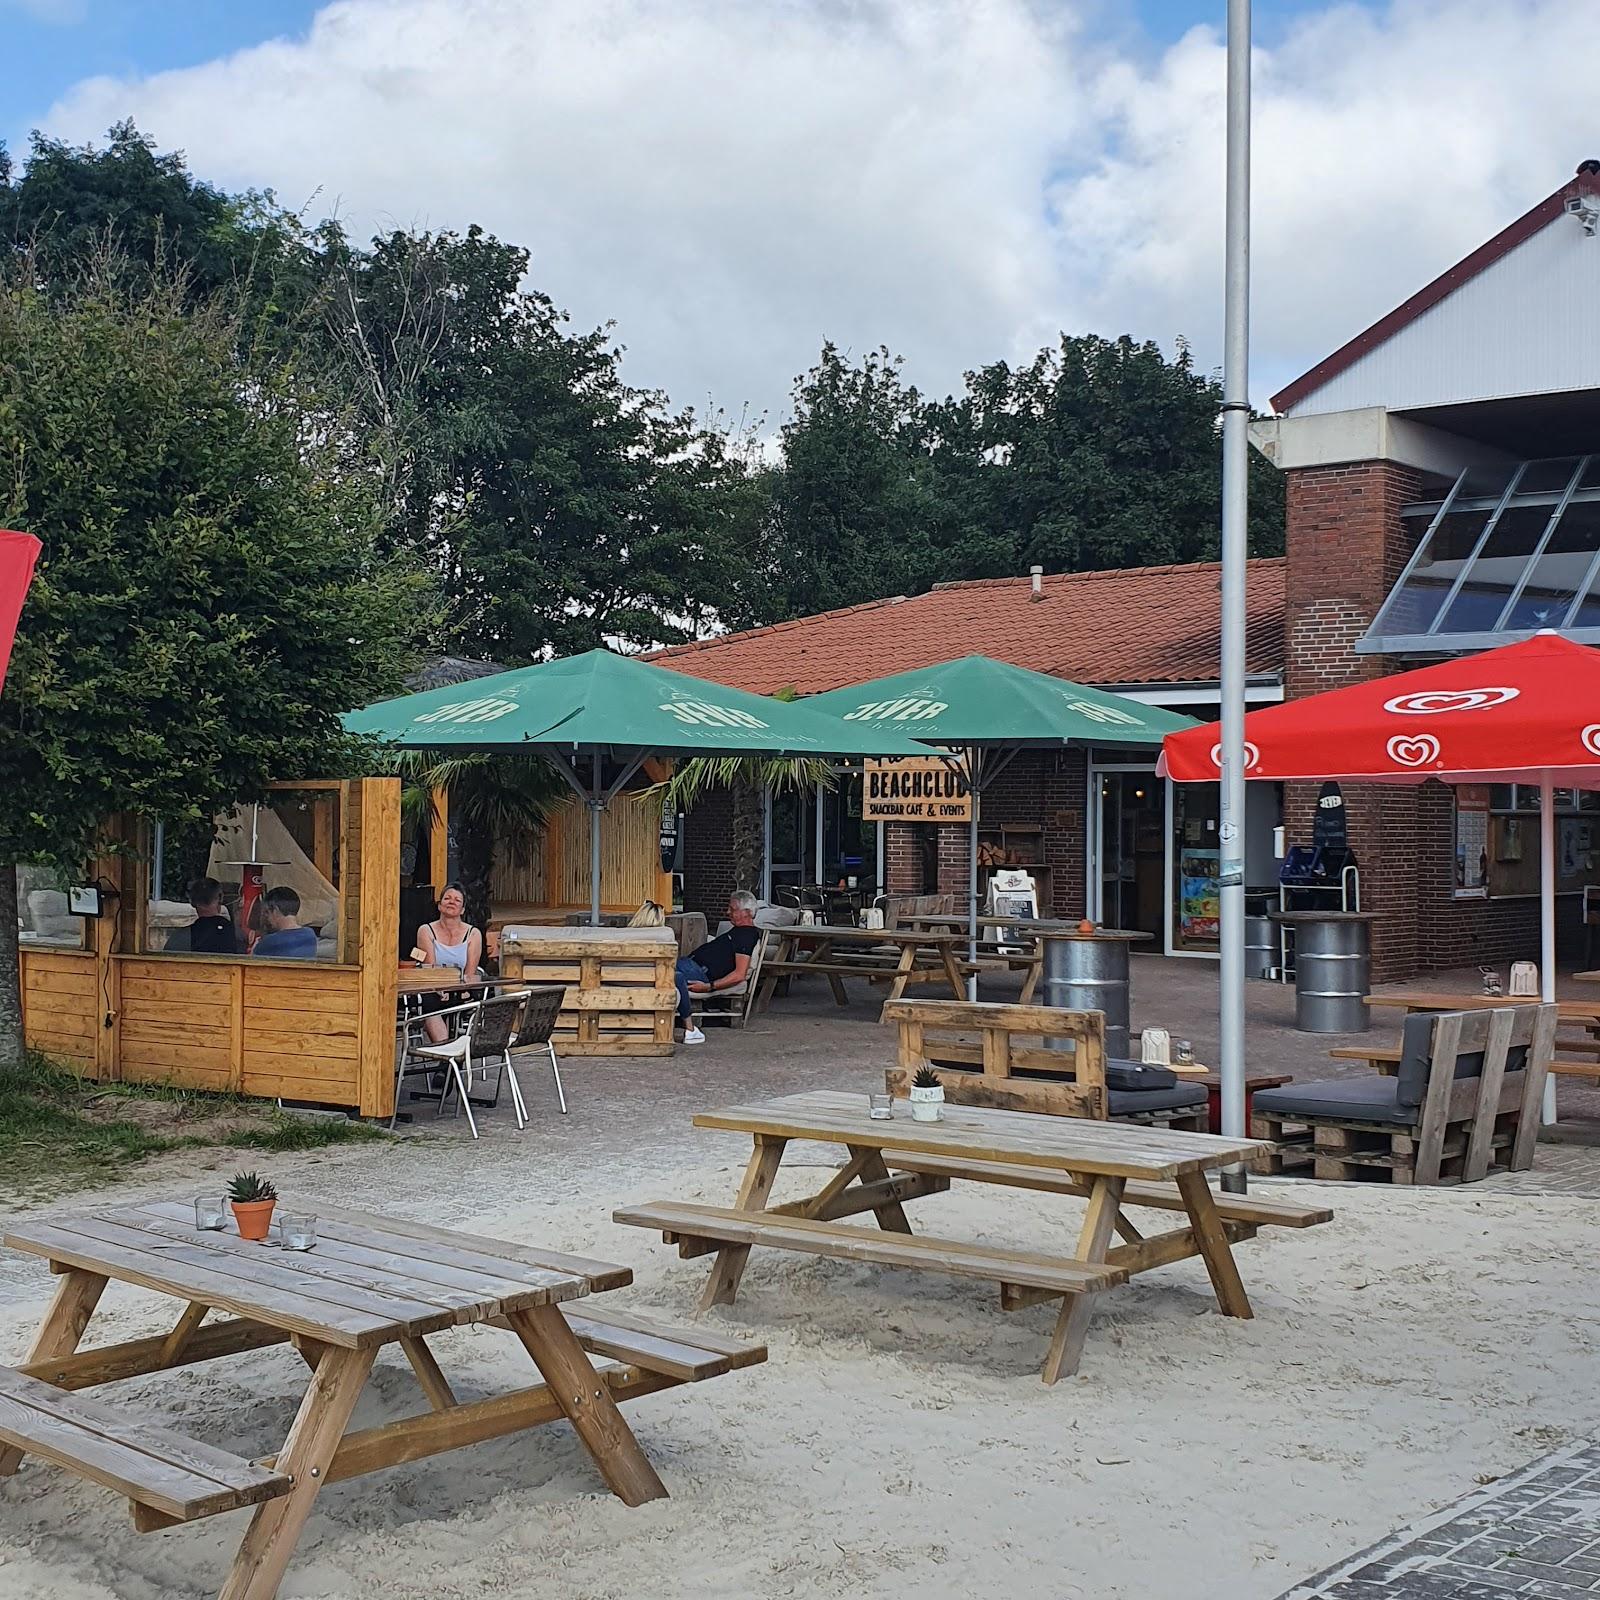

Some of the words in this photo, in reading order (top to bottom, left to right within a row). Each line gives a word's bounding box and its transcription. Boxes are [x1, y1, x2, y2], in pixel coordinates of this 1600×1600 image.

[658, 701, 771, 729] JEVER
[843, 698, 949, 721] JEVER
[869, 804, 904, 816] SNACKBAR
[906, 803, 923, 816] CAFÉ
[926, 804, 937, 817] &
[940, 805, 965, 816] EVENTS
